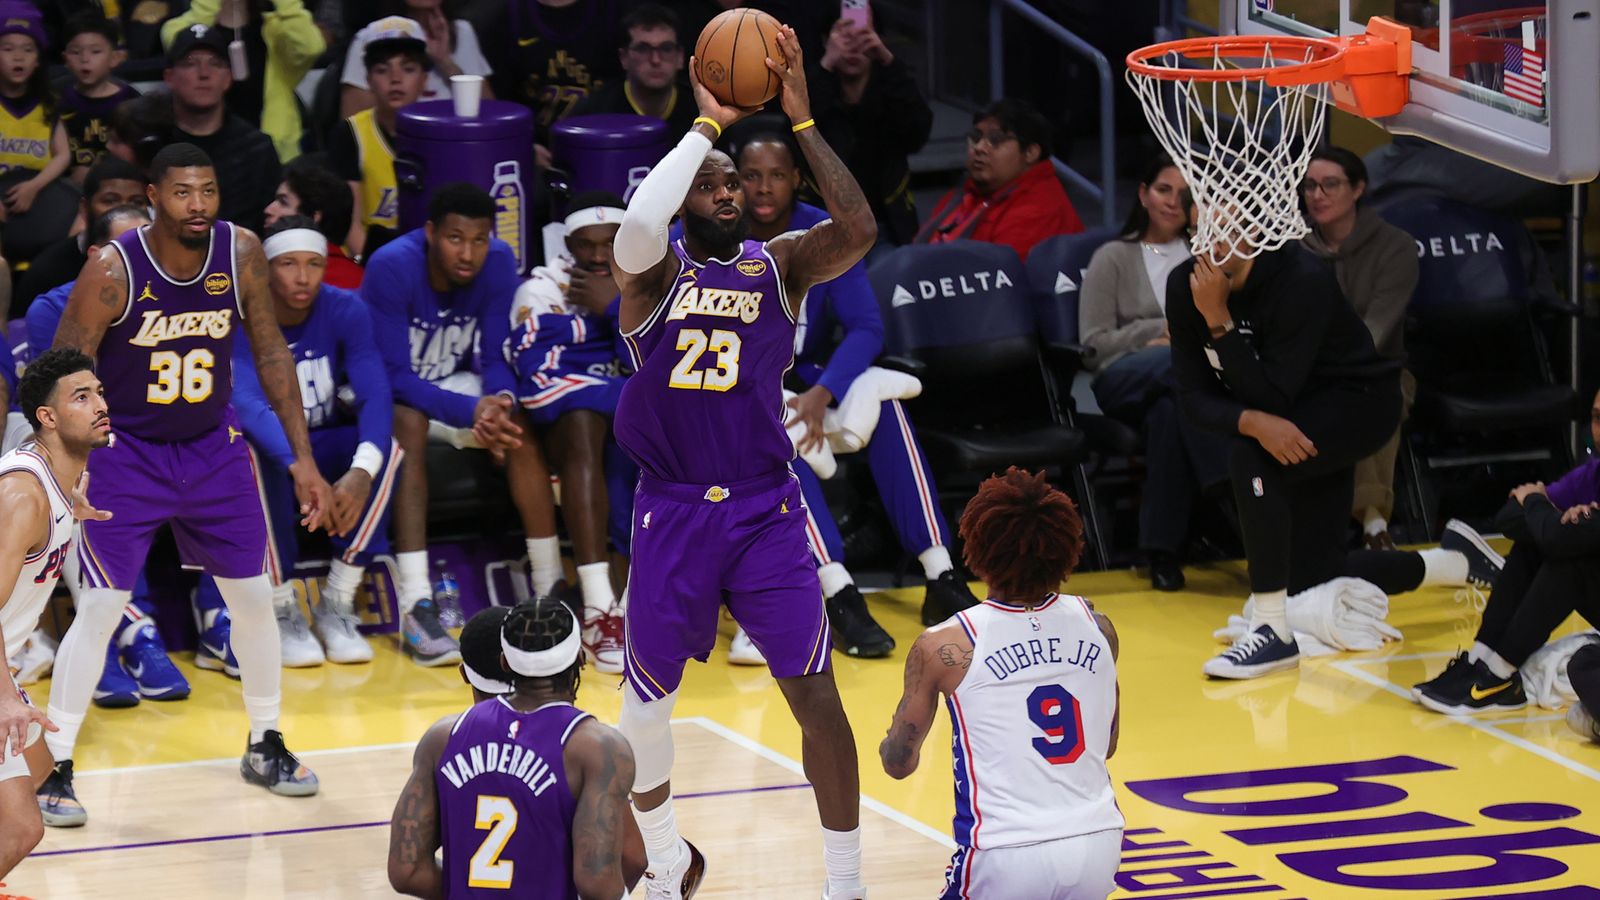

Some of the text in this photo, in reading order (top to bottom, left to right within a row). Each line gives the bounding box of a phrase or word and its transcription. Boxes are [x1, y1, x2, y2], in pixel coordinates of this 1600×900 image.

[0, 136, 48, 159] AKERS
[665, 280, 763, 324] LAKERS
[918, 269, 1013, 300] DELTA
[128, 308, 233, 347] LAKERS
[146, 347, 215, 405] 36
[668, 328, 742, 392] 23
[984, 638, 1101, 681] OUBRE JR.
[1026, 683, 1086, 766] 9
[440, 742, 557, 797] VANDERBILT
[468, 794, 519, 890] 2
[1124, 755, 1600, 900] bib
